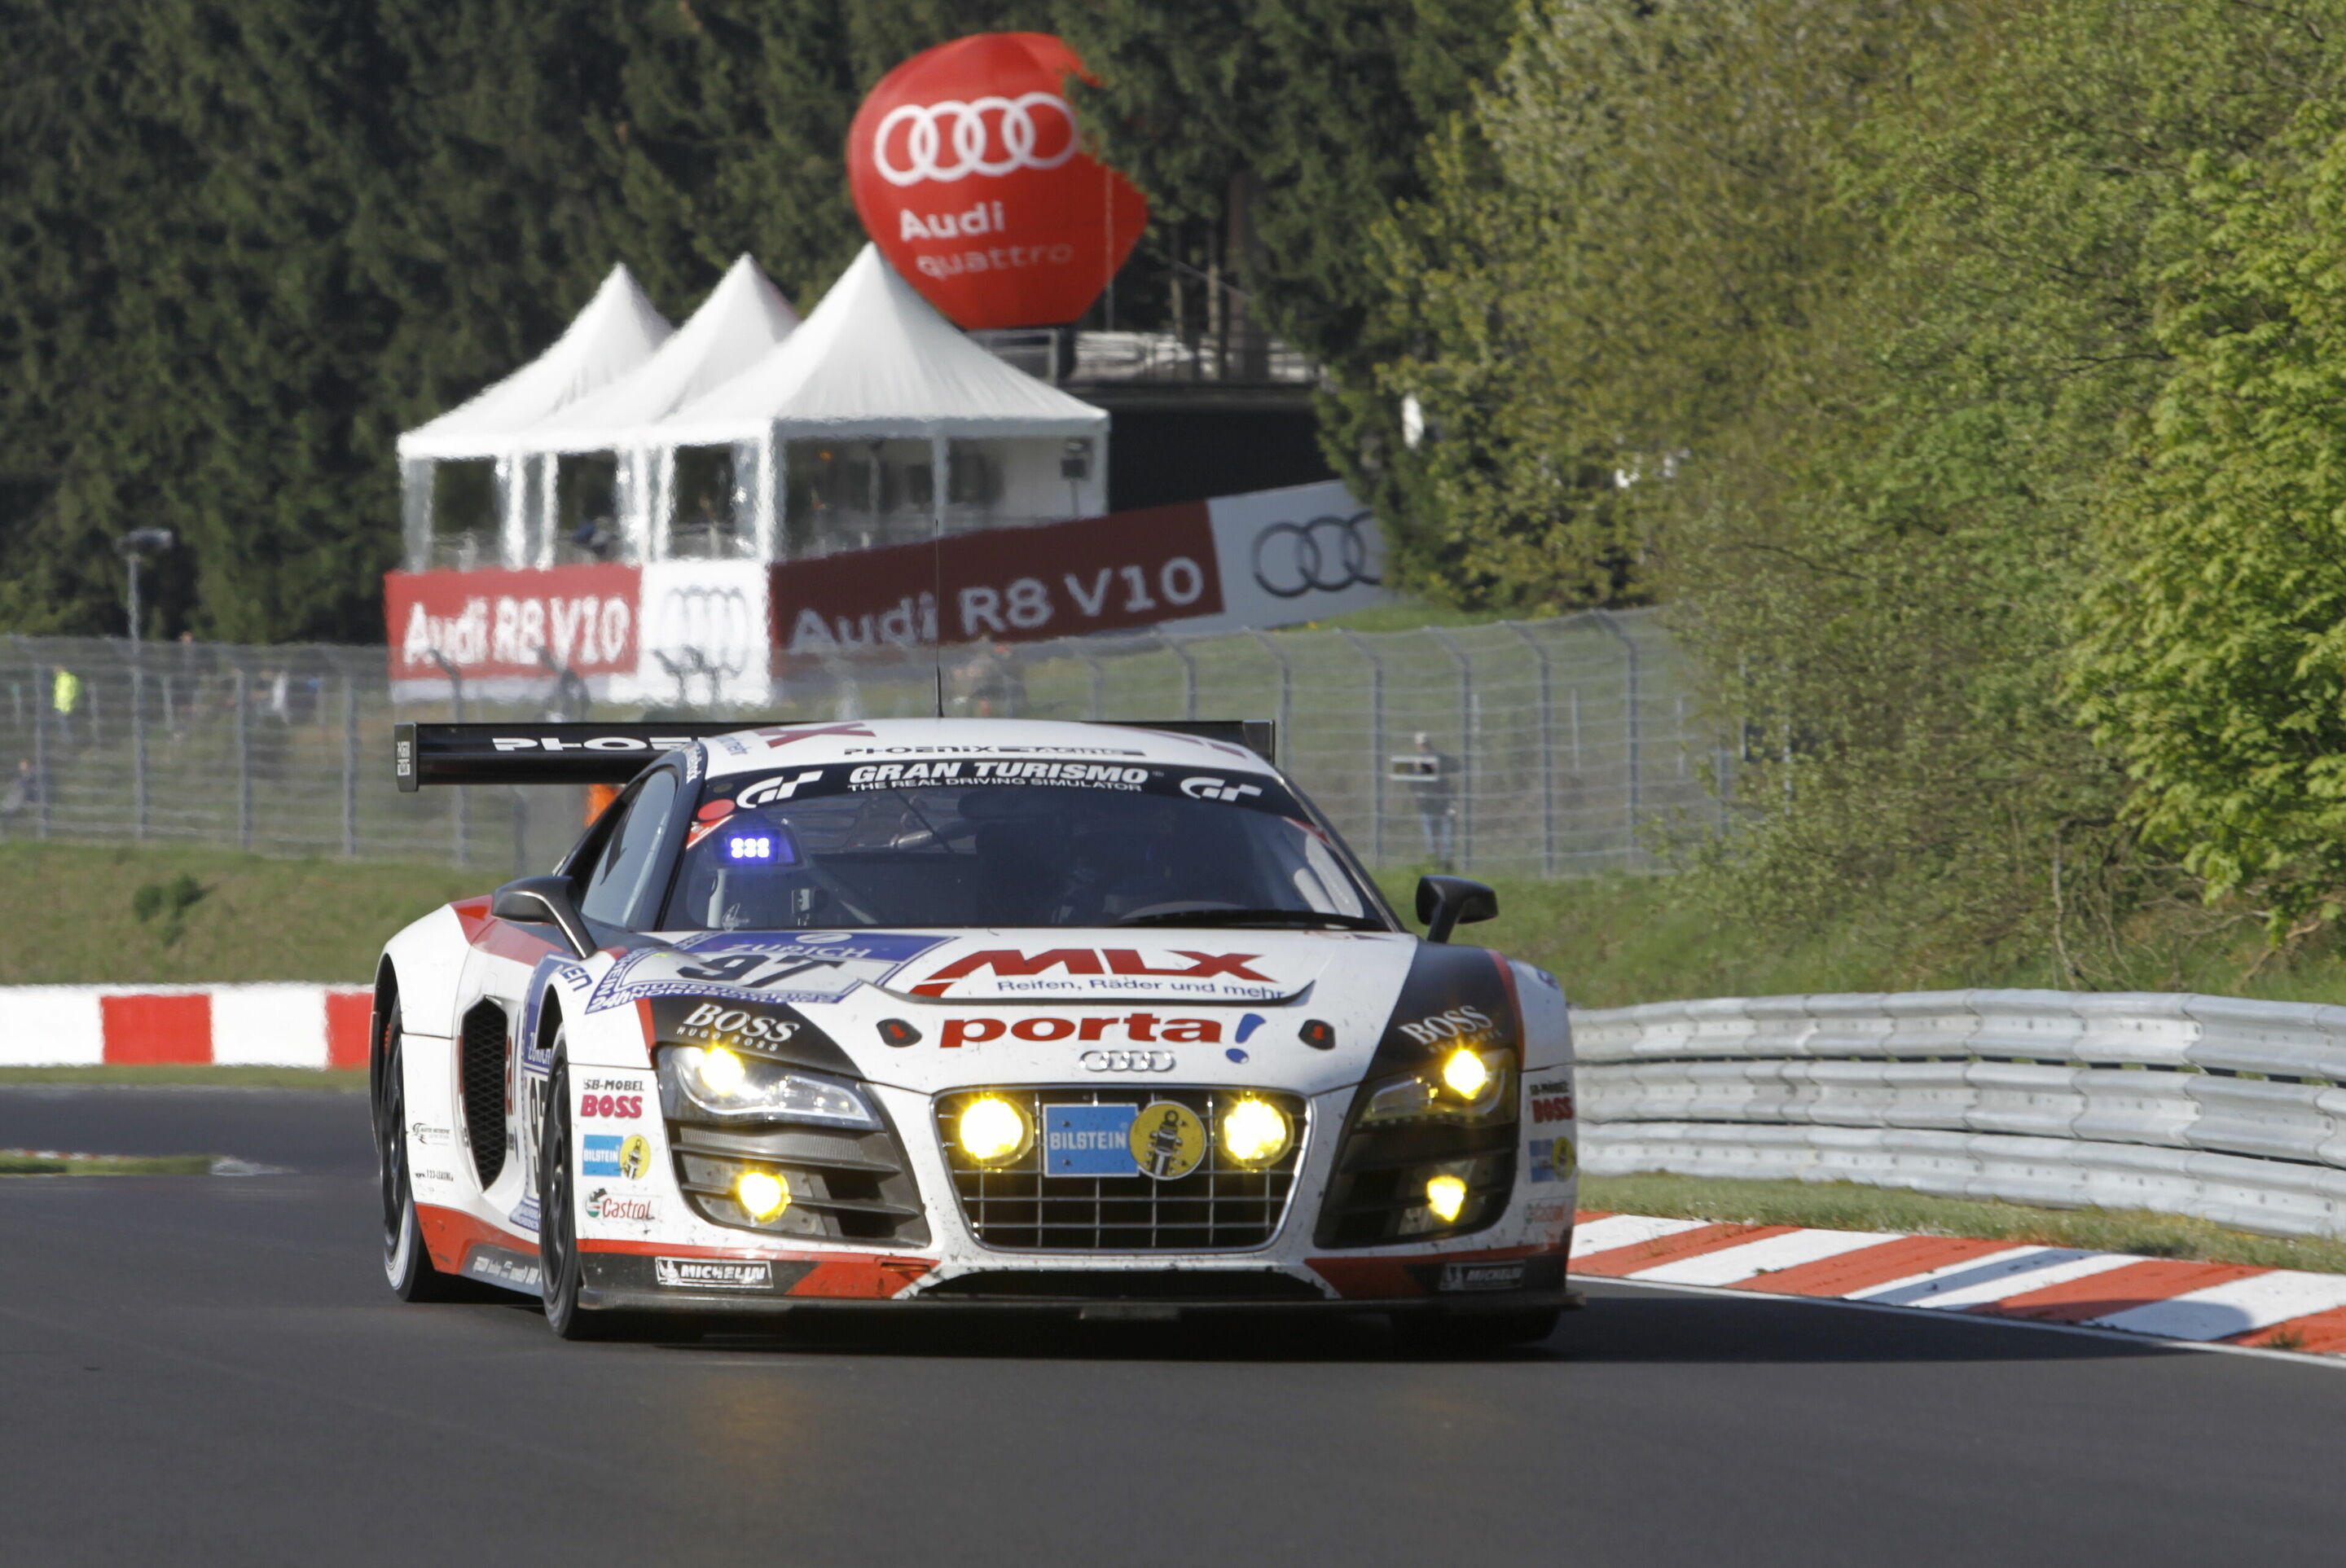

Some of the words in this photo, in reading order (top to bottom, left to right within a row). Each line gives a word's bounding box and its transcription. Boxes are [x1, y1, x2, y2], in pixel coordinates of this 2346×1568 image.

[900, 201, 1004, 242] Audi
[916, 244, 1074, 279] quattro
[790, 591, 936, 650] Audi
[960, 578, 1054, 635] R8
[1064, 557, 1203, 617] V10
[404, 598, 489, 665] Audi
[494, 596, 546, 664] R8
[551, 595, 630, 665] V10
[492, 737, 702, 751] PHOE
[847, 780, 887, 792] THE
[892, 779, 942, 788] REAL
[946, 777, 1026, 786] DRIVING
[1030, 778, 1142, 792] SIMULATOR
[849, 762, 962, 784] GRAN
[974, 762, 1149, 784] TURISMO
[720, 944, 872, 957] ZURICH
[676, 954, 846, 988] 97
[907, 948, 1280, 997] MLX
[997, 978, 1082, 992] Reifen,
[1090, 977, 1162, 990] Räder
[1170, 978, 1217, 994] und
[1223, 981, 1285, 999] mehr
[683, 1004, 801, 1043] BOSS
[1398, 1005, 1493, 1045] BOSS
[676, 1026, 722, 1040] HUGO
[731, 1034, 779, 1052] BOSS
[581, 1095, 643, 1118] BOSS
[1532, 1096, 1574, 1123] BOSS
[1050, 1131, 1127, 1149] BILSTEIN
[583, 1148, 619, 1162] BILSTEIN
[602, 1197, 652, 1219] Castrol
[681, 1266, 766, 1280] MICHELIN
